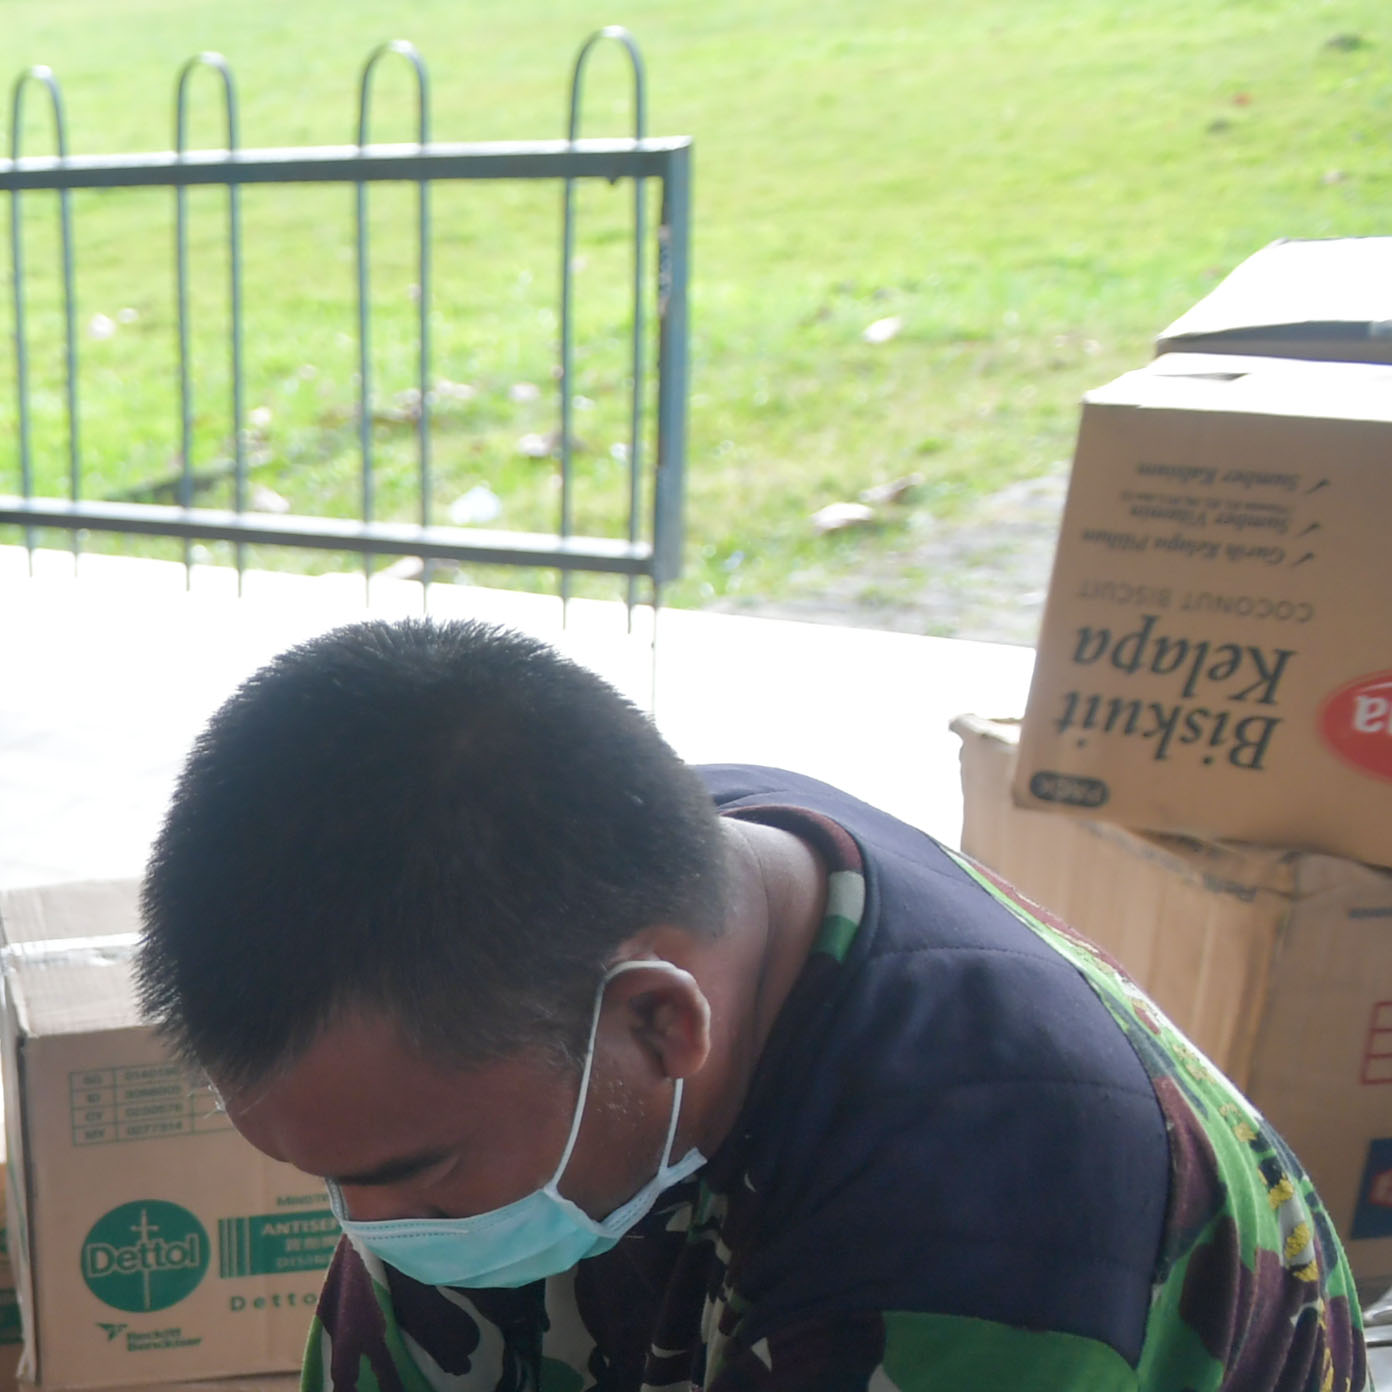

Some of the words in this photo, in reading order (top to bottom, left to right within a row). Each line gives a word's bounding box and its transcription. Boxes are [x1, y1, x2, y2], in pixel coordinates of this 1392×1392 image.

[1075, 579, 1174, 610] BISCUIT
[1180, 593, 1315, 624] COCONUT
[1069, 613, 1300, 707] Kelapa
[1052, 690, 1283, 772] Biskuit
[84, 1232, 201, 1279] Dettol
[228, 1291, 318, 1313] Detto
